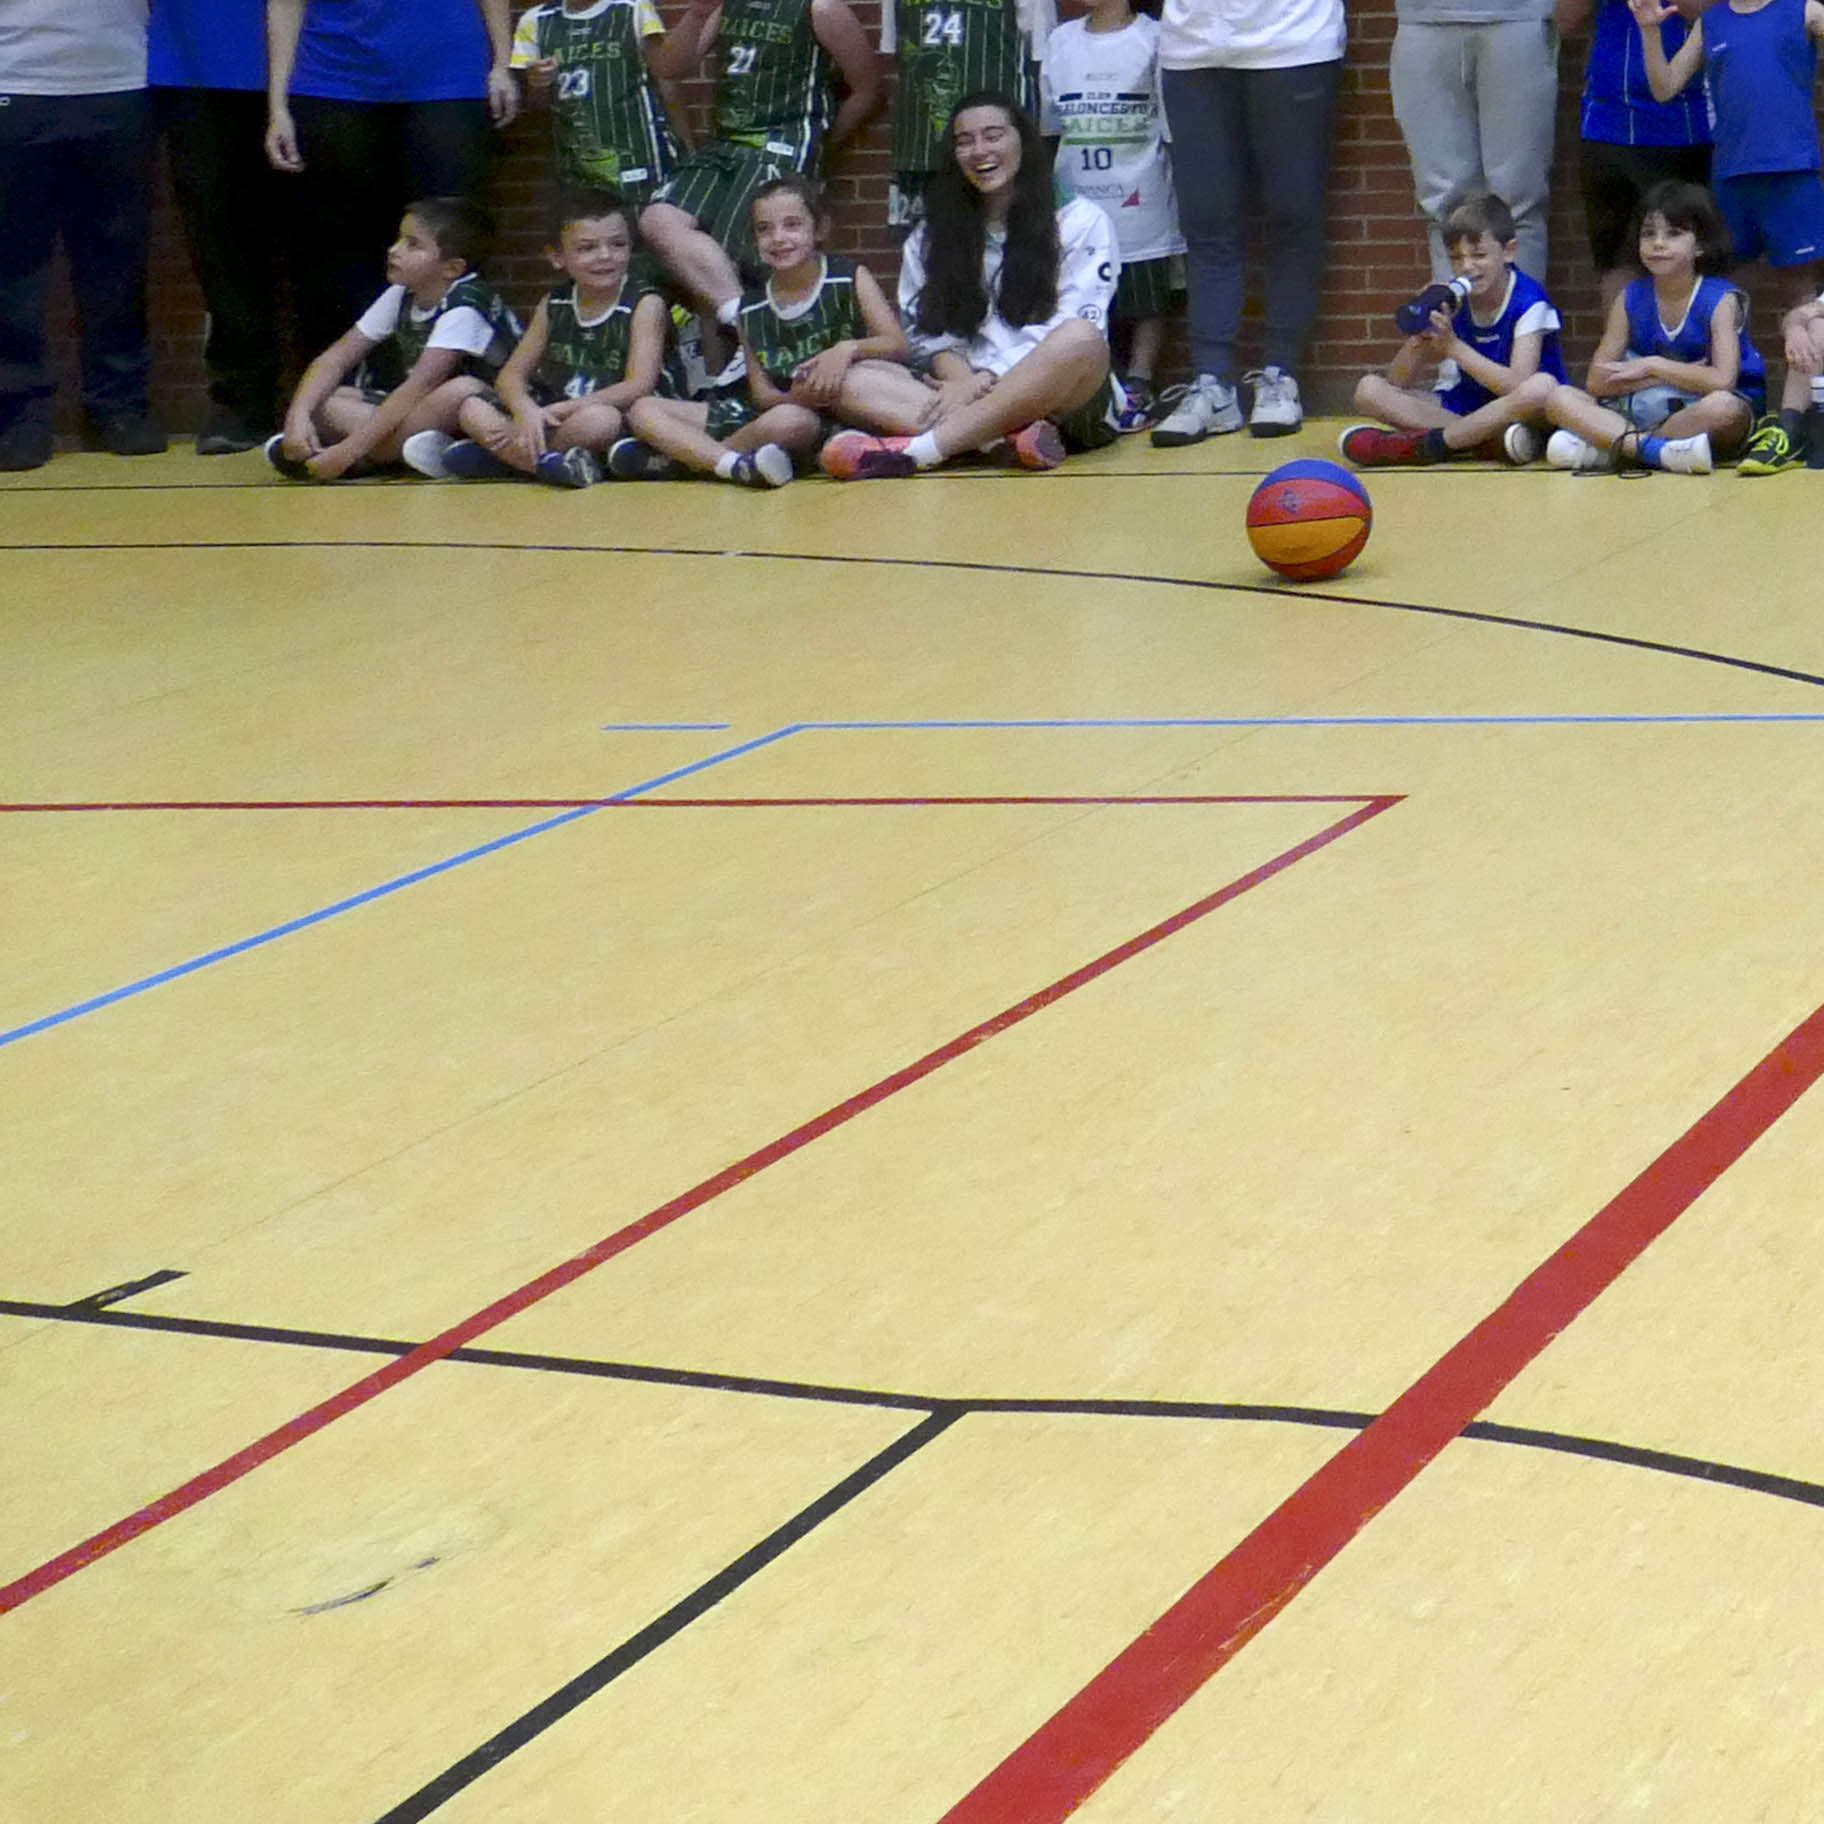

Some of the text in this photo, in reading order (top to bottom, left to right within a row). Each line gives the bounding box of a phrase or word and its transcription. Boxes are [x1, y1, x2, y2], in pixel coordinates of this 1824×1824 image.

[924, 12, 964, 44] 24
[727, 46, 756, 75] 21
[1081, 147, 1112, 171] 10
